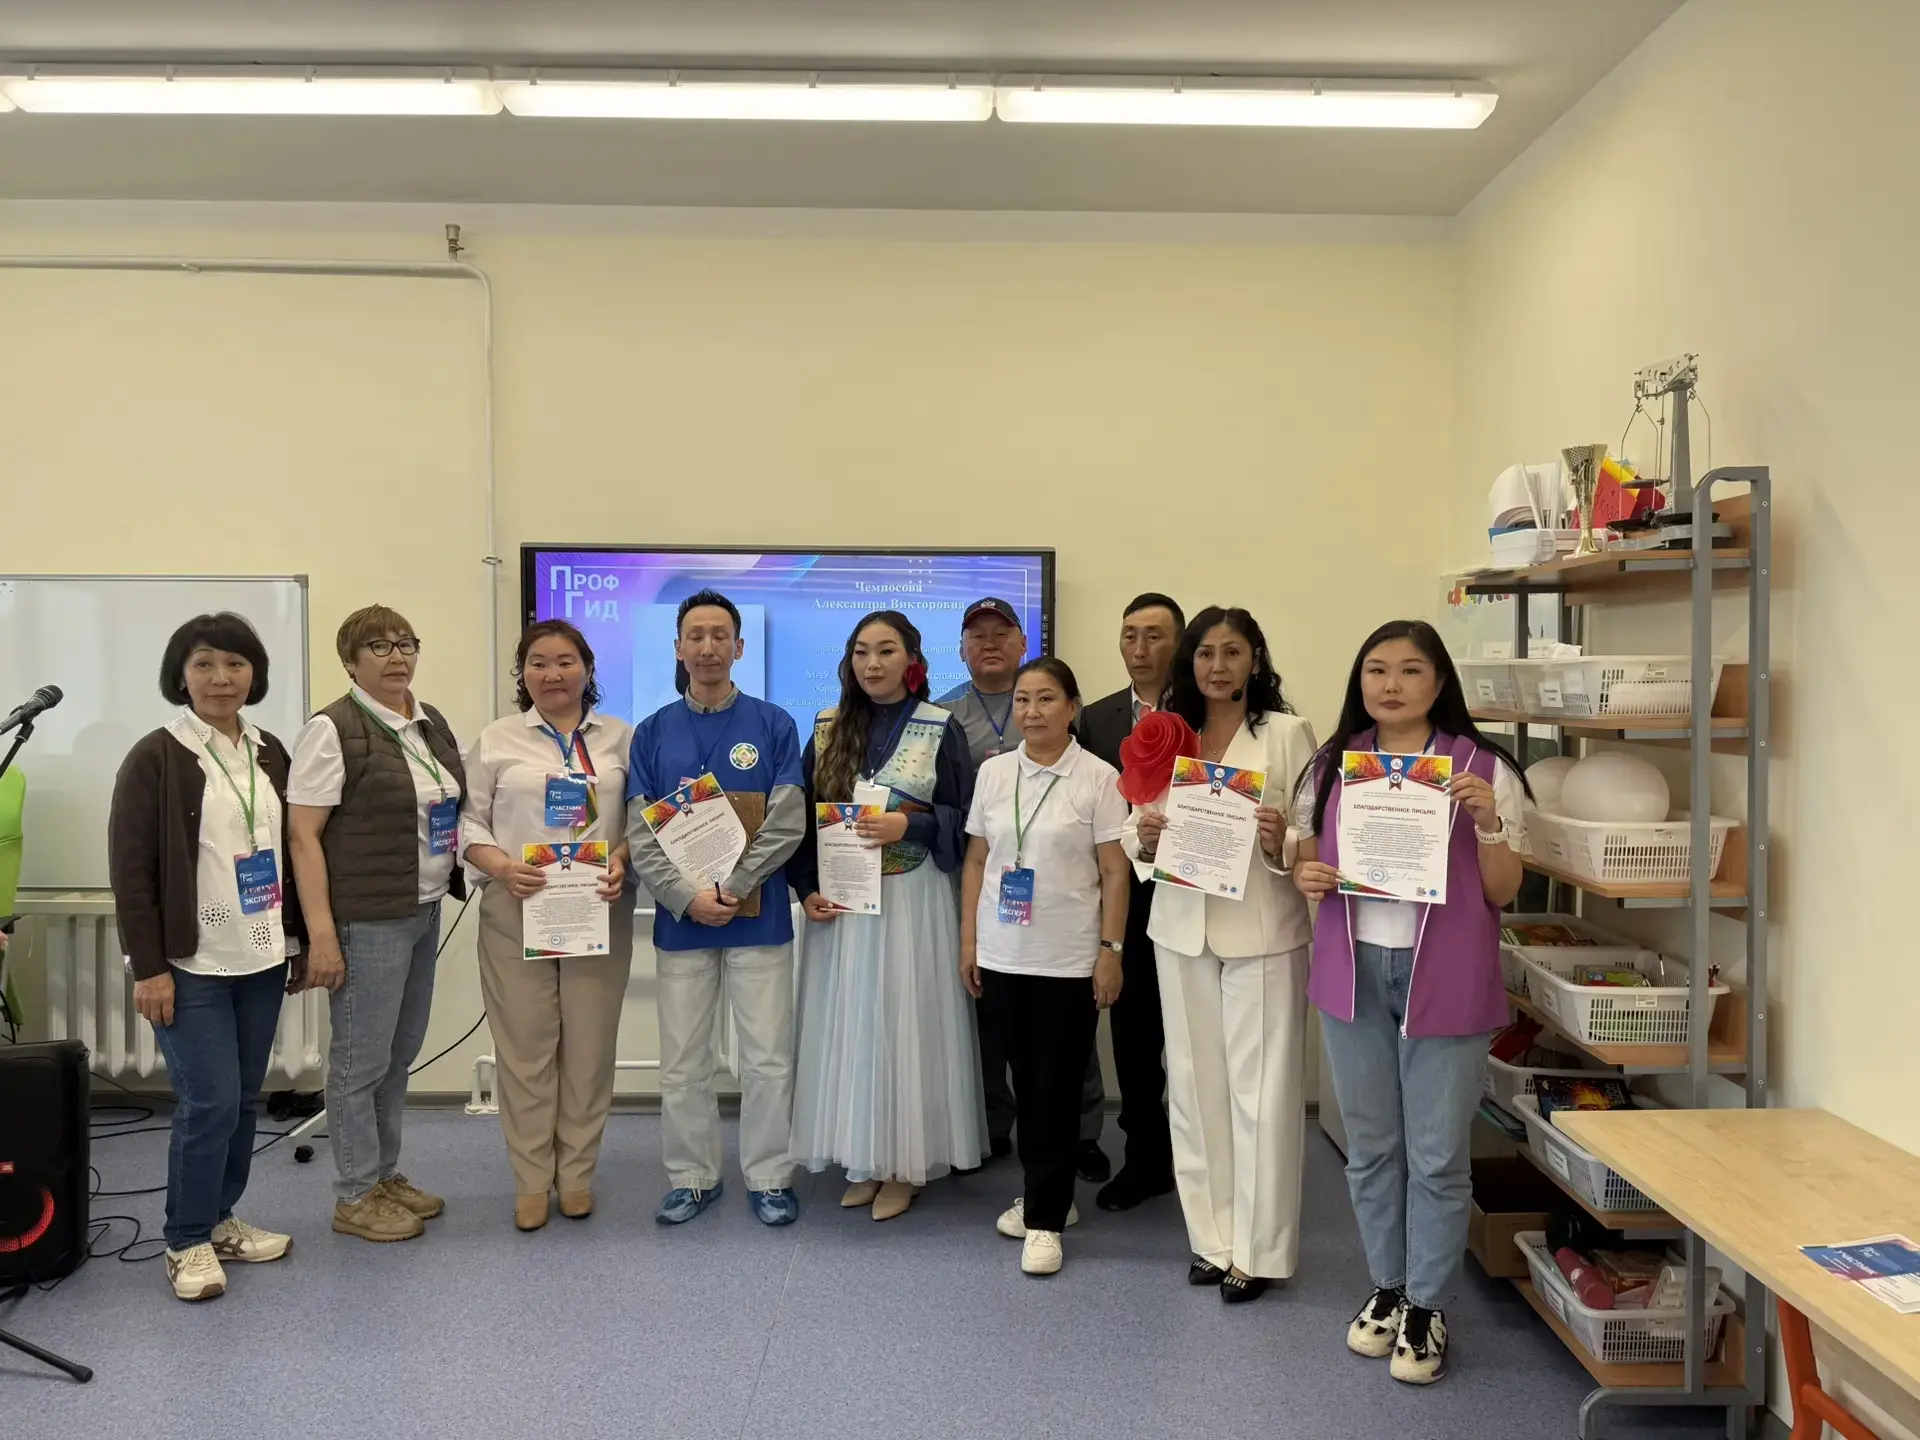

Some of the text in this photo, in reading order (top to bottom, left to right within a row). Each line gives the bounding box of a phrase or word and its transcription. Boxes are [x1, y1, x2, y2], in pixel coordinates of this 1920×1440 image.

[855, 581, 923, 593] Чемпосова
[813, 598, 965, 611] Александра Викторовна
[1411, 808, 1437, 816] ПИСЬМО
[244, 893, 277, 906] ЭКСПЕРТ
